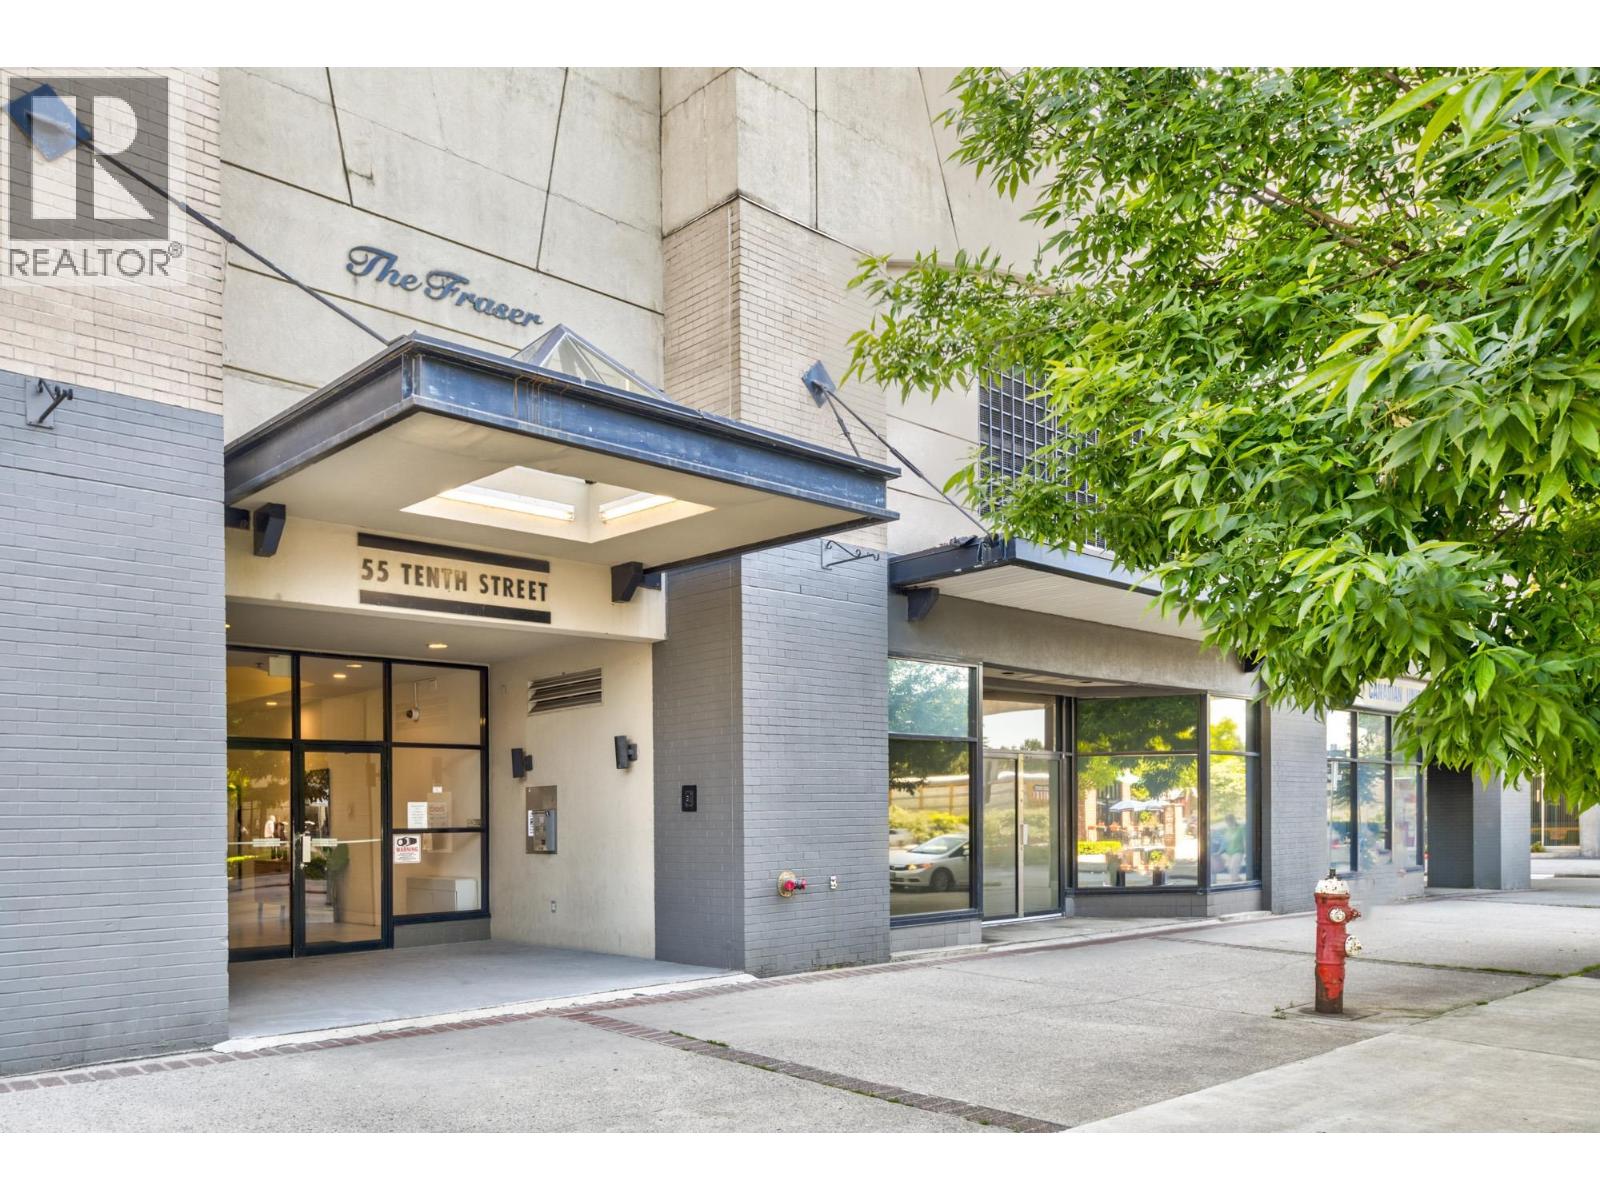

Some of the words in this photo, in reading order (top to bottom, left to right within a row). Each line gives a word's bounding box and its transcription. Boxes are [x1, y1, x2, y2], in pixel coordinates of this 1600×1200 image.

[346, 246, 422, 291] The
[424, 270, 544, 327] Fraser
[361, 558, 389, 582] 55
[401, 563, 467, 592] TENTH
[479, 573, 548, 602] STREET
